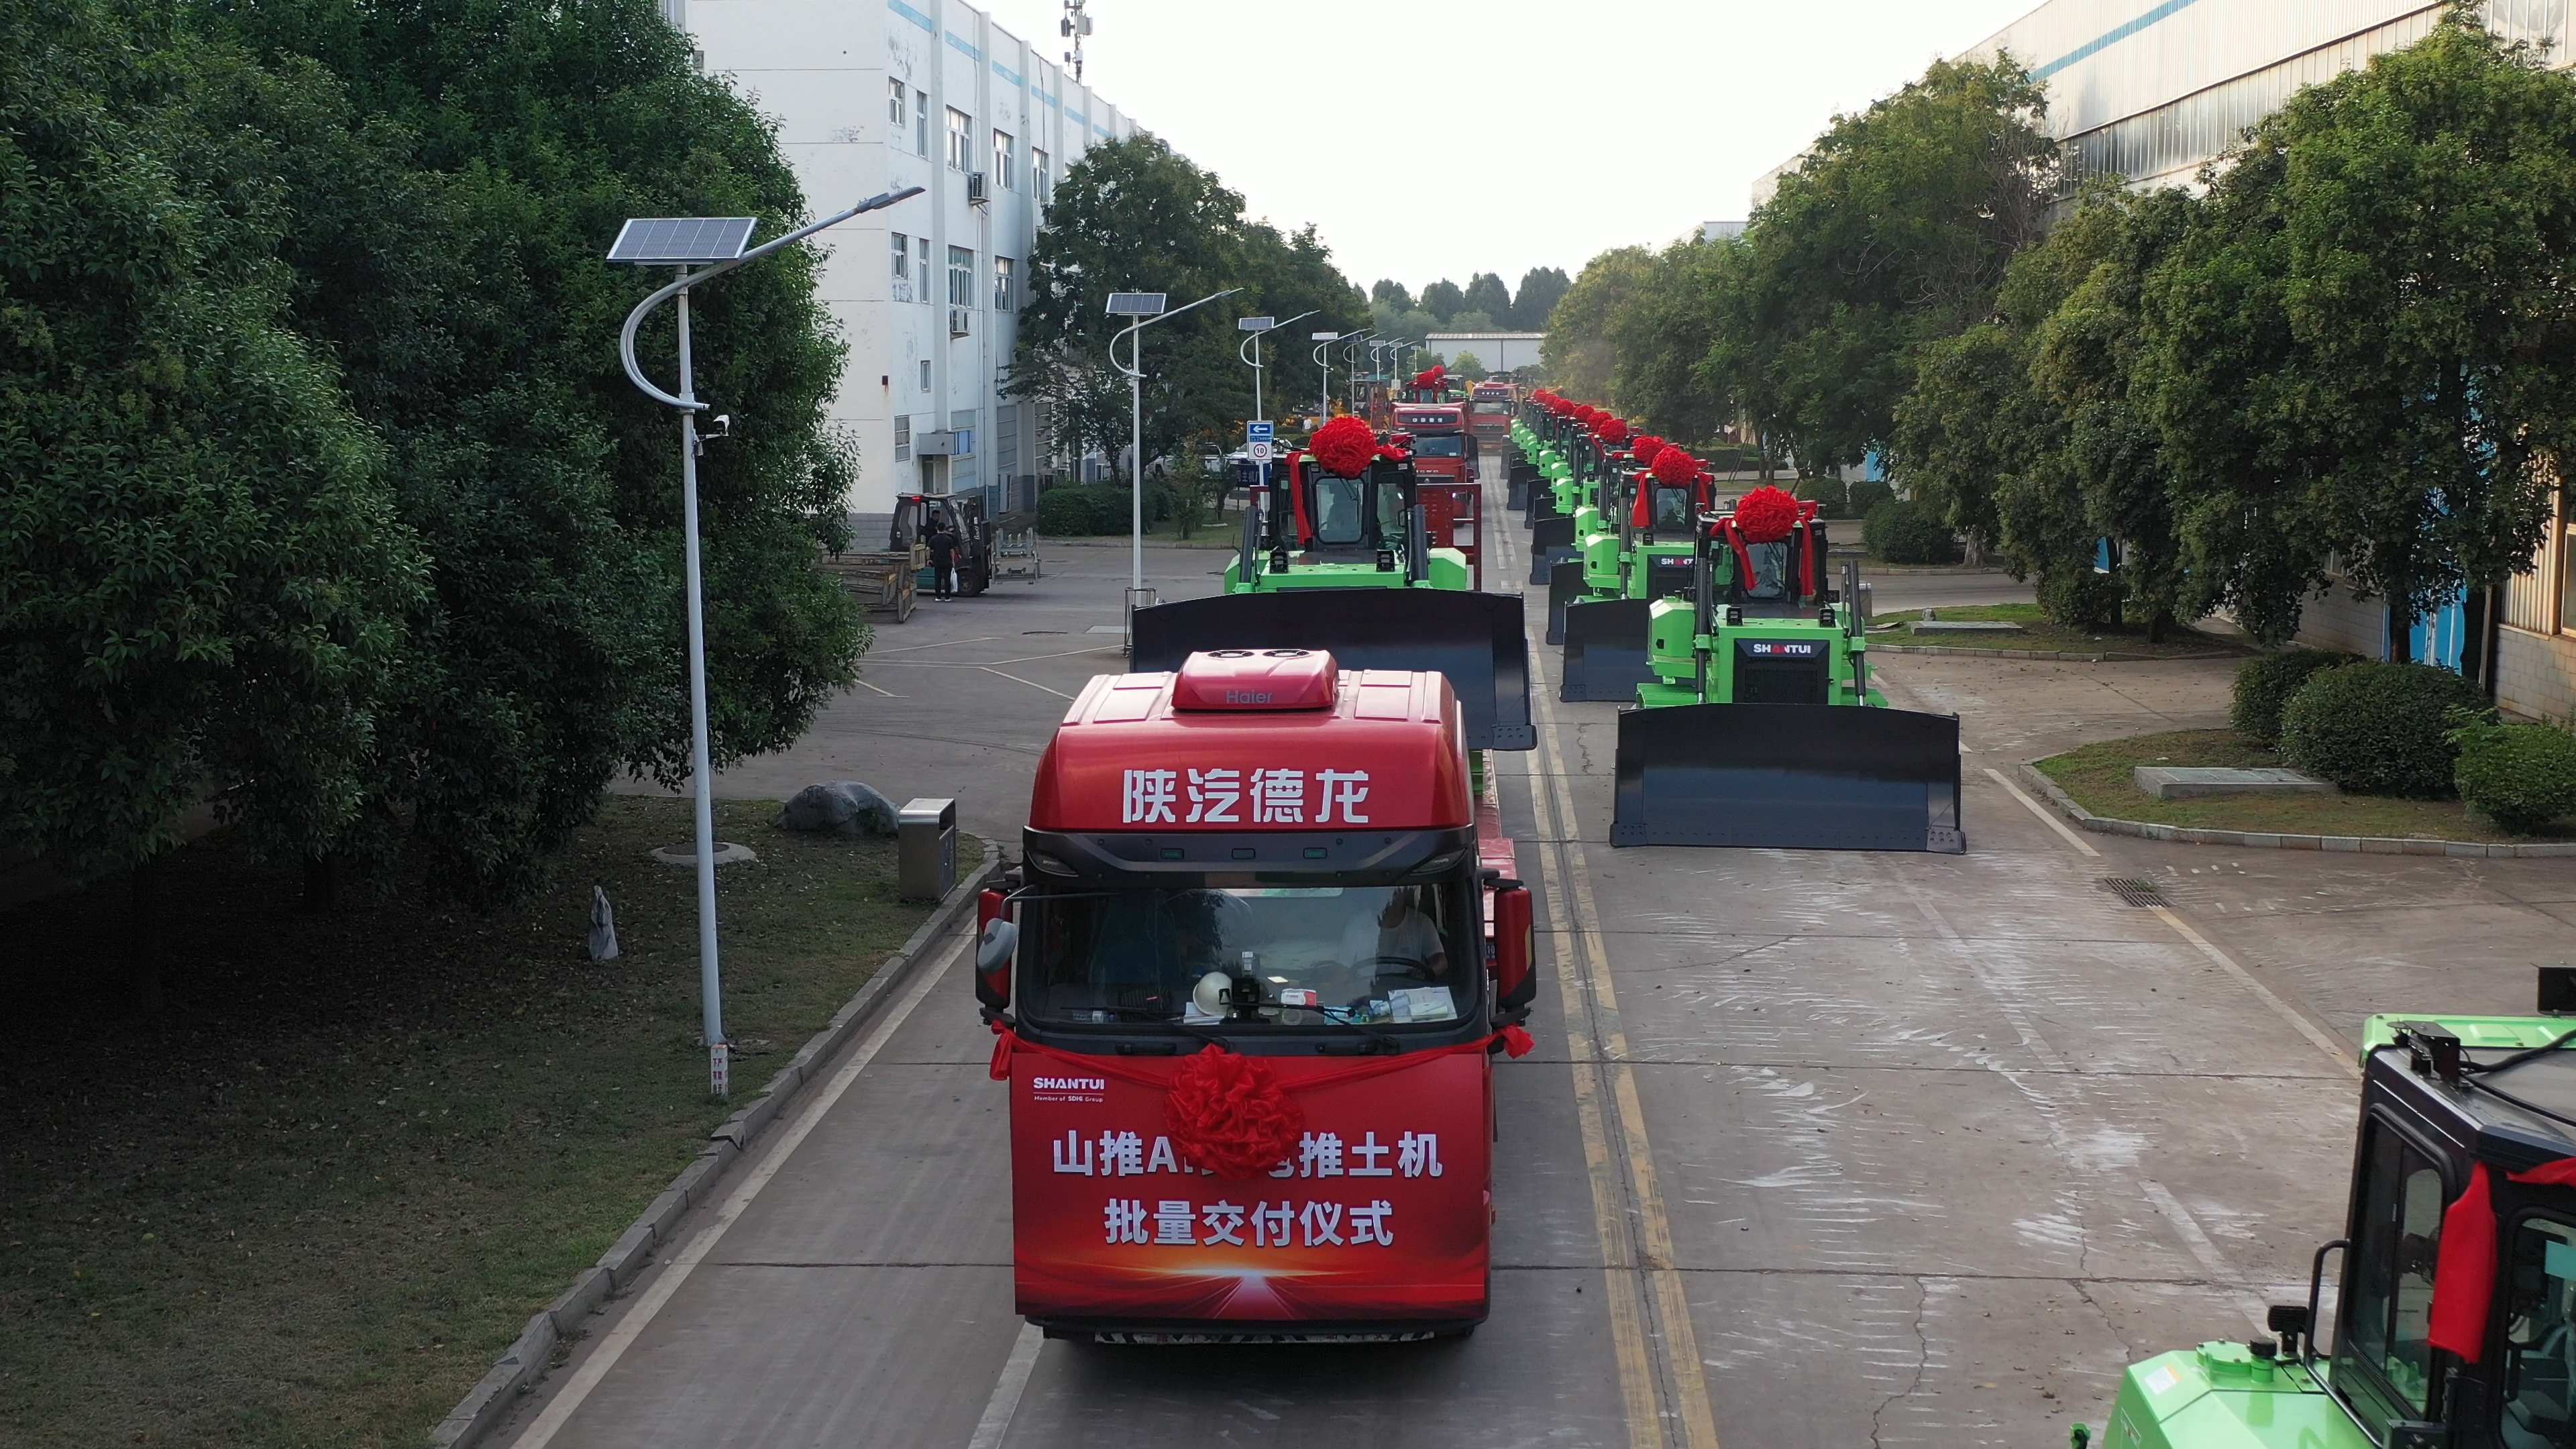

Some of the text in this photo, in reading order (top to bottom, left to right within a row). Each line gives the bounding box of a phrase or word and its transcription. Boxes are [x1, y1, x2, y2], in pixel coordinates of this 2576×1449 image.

[1754, 644, 1811, 653] SHANTUI
[1226, 690, 1273, 704] Haier
[1123, 768, 1369, 823] 陕汽德龙
[1033, 1077, 1105, 1089] SHANTUI
[1104, 1198, 1394, 1246] 批量交付仪式
